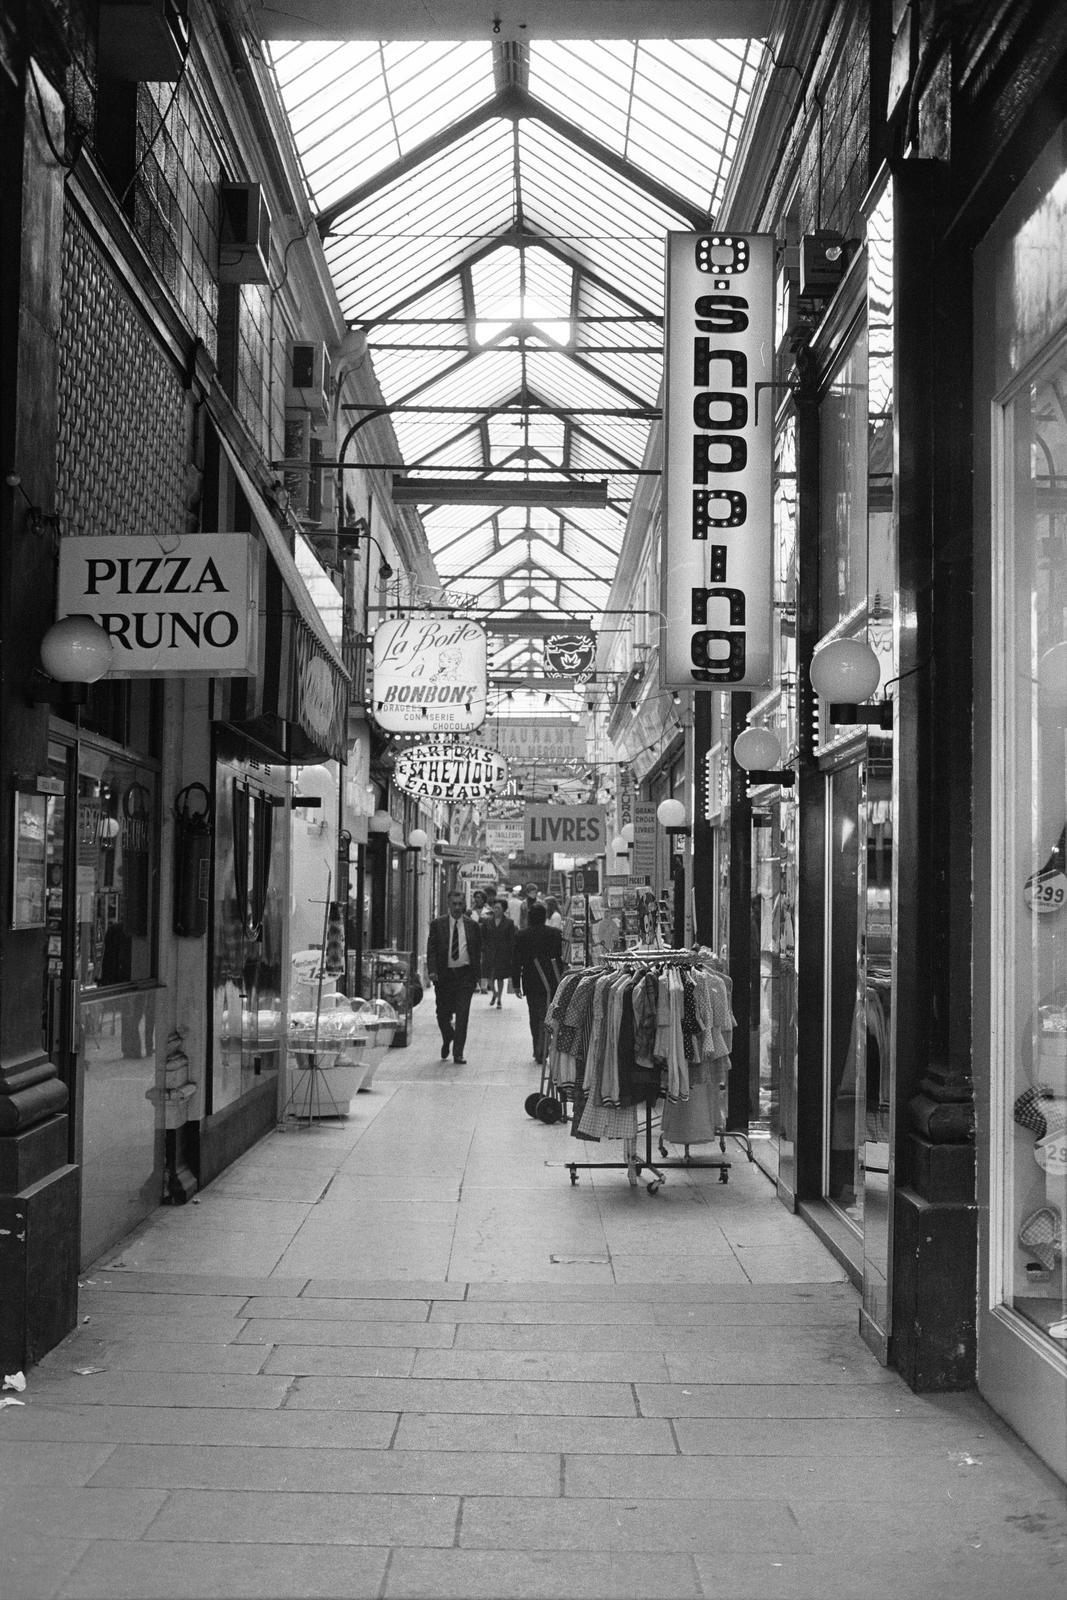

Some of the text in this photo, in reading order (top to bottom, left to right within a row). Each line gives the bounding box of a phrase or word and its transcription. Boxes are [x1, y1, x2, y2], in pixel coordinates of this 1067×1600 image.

[83, 556, 230, 595] PIZZA
[66, 611, 239, 650] RUNO
[375, 620, 410, 670] La
[384, 685, 478, 703] BONBONS
[404, 713, 455, 721] CONSERIE
[432, 723, 475, 731] CHOCOLAT
[399, 761, 505, 784] ESTHETIQUE
[405, 777, 497, 798] CADEAUX
[530, 817, 600, 842] LIVRES
